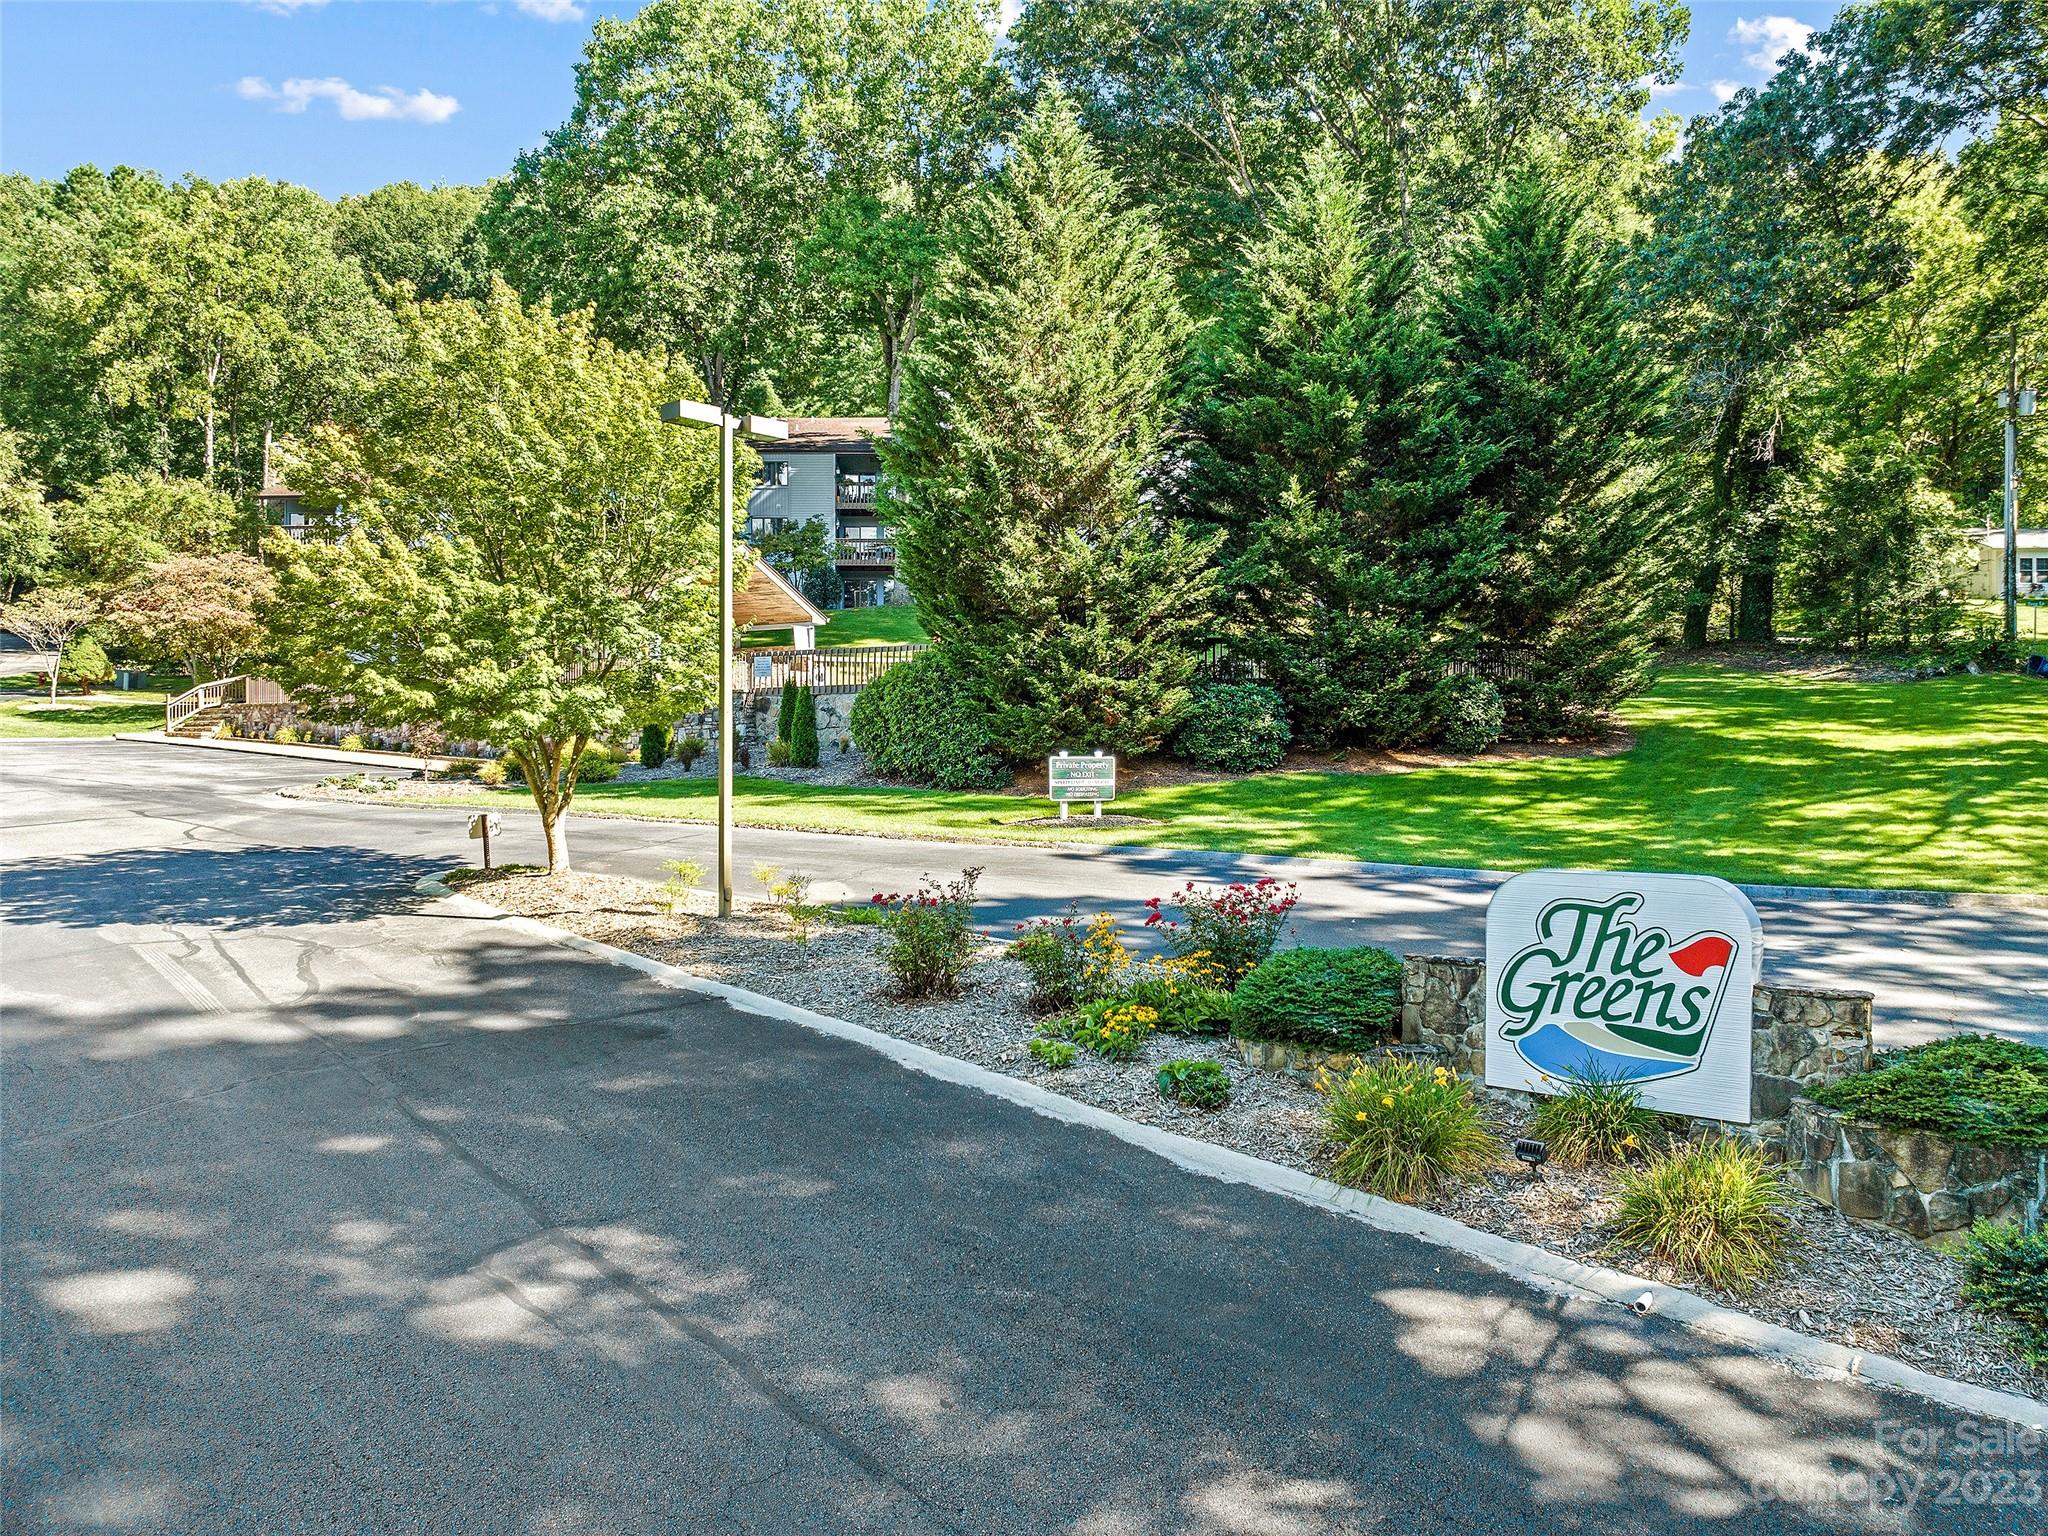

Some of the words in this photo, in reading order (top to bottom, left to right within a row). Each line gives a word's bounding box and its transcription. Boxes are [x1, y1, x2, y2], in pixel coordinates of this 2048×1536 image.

[1081, 761, 1108, 770] Property
[1541, 898, 1666, 978] The
[1501, 948, 1711, 1036] Greens
